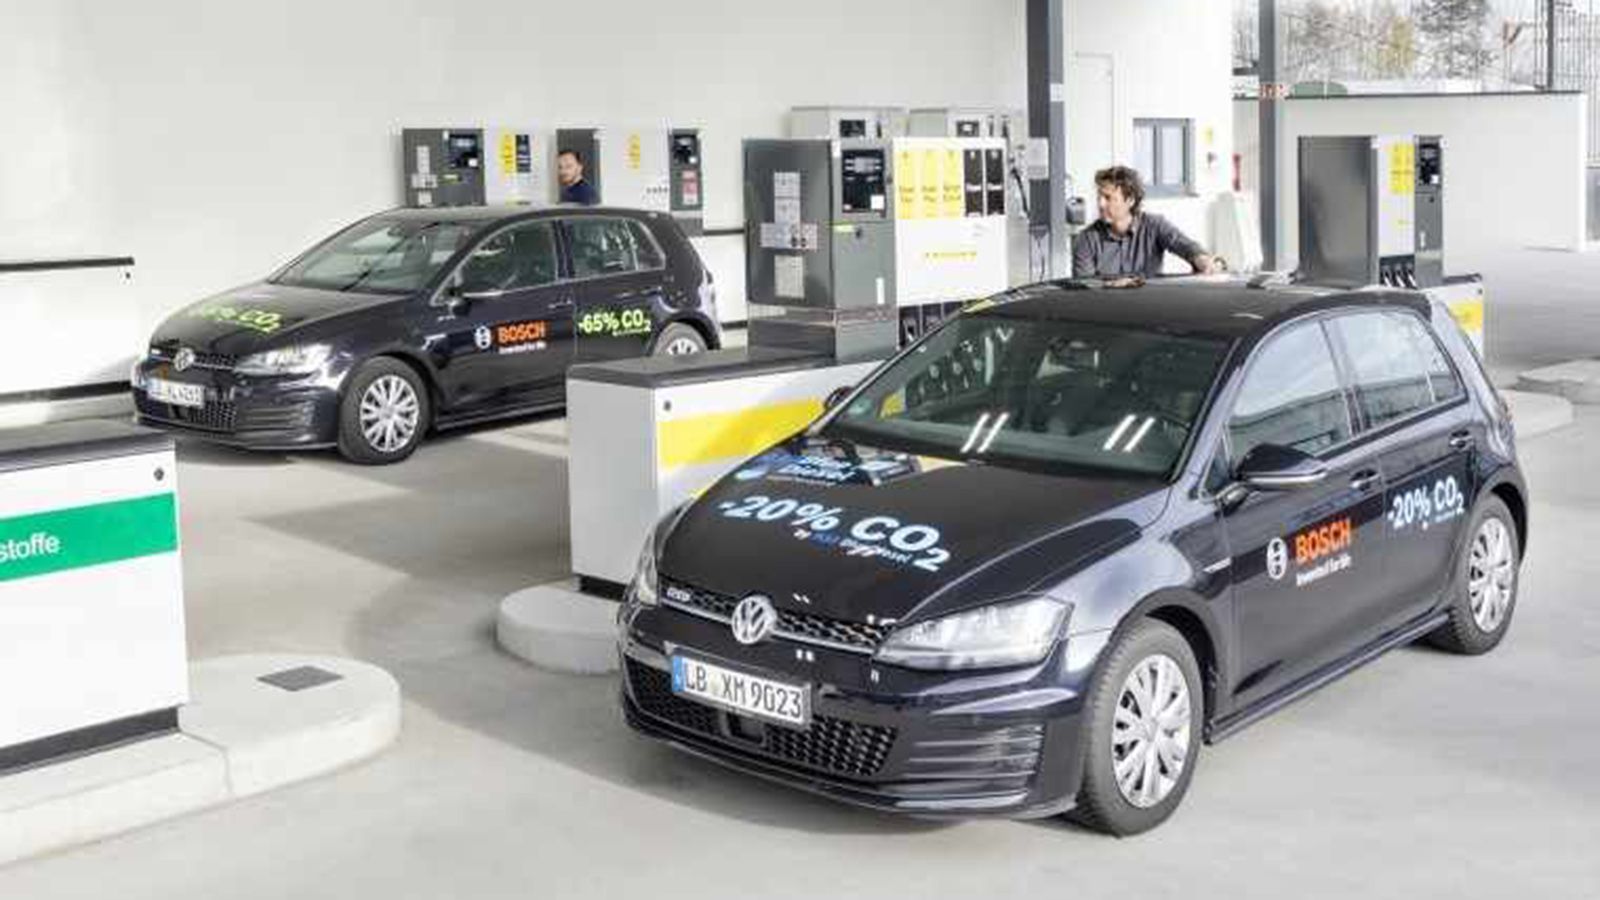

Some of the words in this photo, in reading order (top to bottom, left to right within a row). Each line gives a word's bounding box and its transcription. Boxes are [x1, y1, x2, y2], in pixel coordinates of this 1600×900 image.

[498, 321, 546, 343] BOSCH
[578, 311, 620, 334] -65%
[718, 495, 844, 532] -20%
[1387, 485, 1431, 530] -20%
[1295, 518, 1351, 564] BOSCH
[685, 662, 708, 692] LB
[721, 673, 746, 705] XM
[750, 681, 801, 719] 9023
